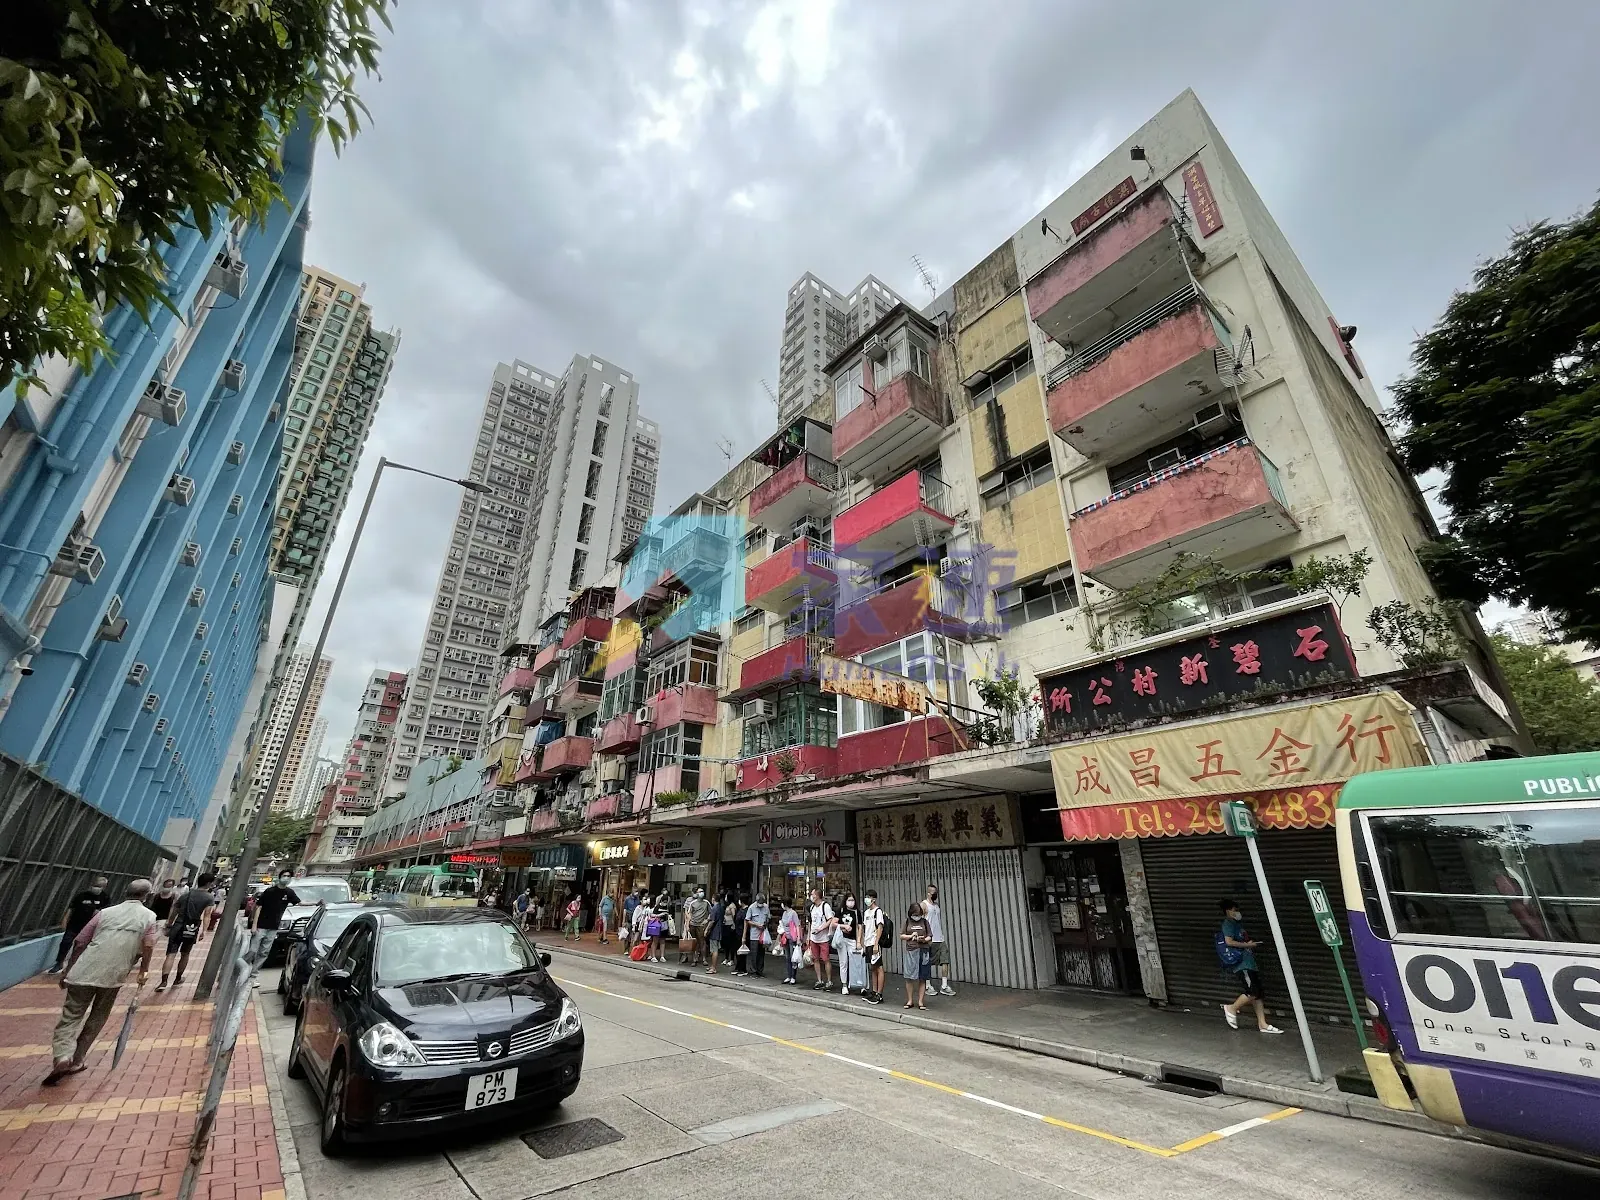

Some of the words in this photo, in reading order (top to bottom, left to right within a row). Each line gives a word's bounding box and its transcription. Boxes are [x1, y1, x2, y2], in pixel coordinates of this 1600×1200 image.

[1050, 625, 1330, 714] 石碧新村公所
[1074, 713, 1397, 797] 成昌五金行
[775, 821, 810, 840] Circle
[813, 818, 826, 837] K
[1116, 806, 1175, 834] Tel:
[1423, 1018, 1473, 1035] One
[484, 1071, 505, 1090] PM
[475, 1087, 507, 1106] 873
